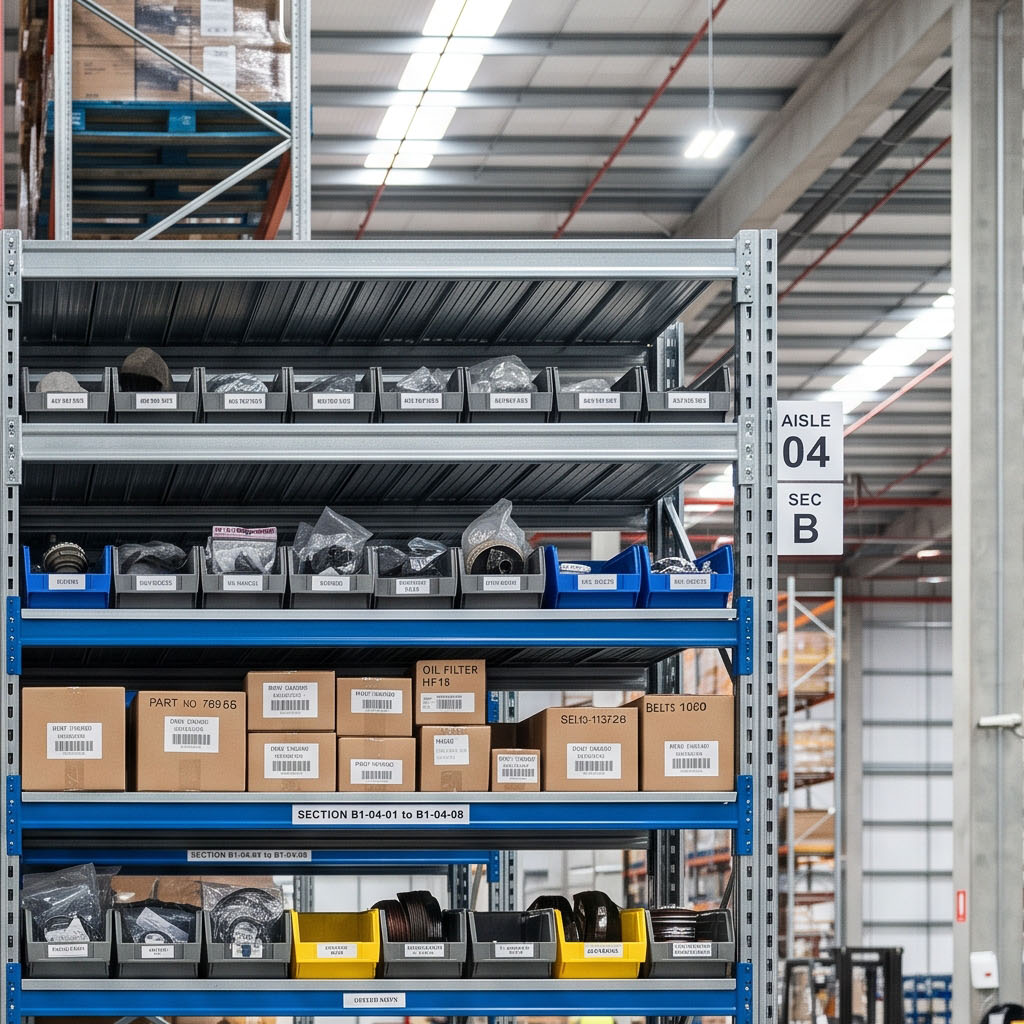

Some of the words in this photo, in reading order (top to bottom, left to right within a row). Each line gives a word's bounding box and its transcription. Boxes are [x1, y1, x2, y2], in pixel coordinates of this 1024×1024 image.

[782, 414, 831, 428] AISLE
[783, 436, 830, 468] 04
[788, 493, 822, 506] SEC
[794, 513, 819, 544] B
[422, 665, 440, 674] OIL
[444, 665, 478, 674] FILTER
[149, 698, 178, 707] PART
[183, 699, 197, 708] NO
[645, 702, 676, 712] BELTS
[297, 810, 347, 819] SECTION
[352, 810, 397, 819] B1-04-01
[402, 810, 412, 819] to
[416, 810, 464, 819] B1-04-08
